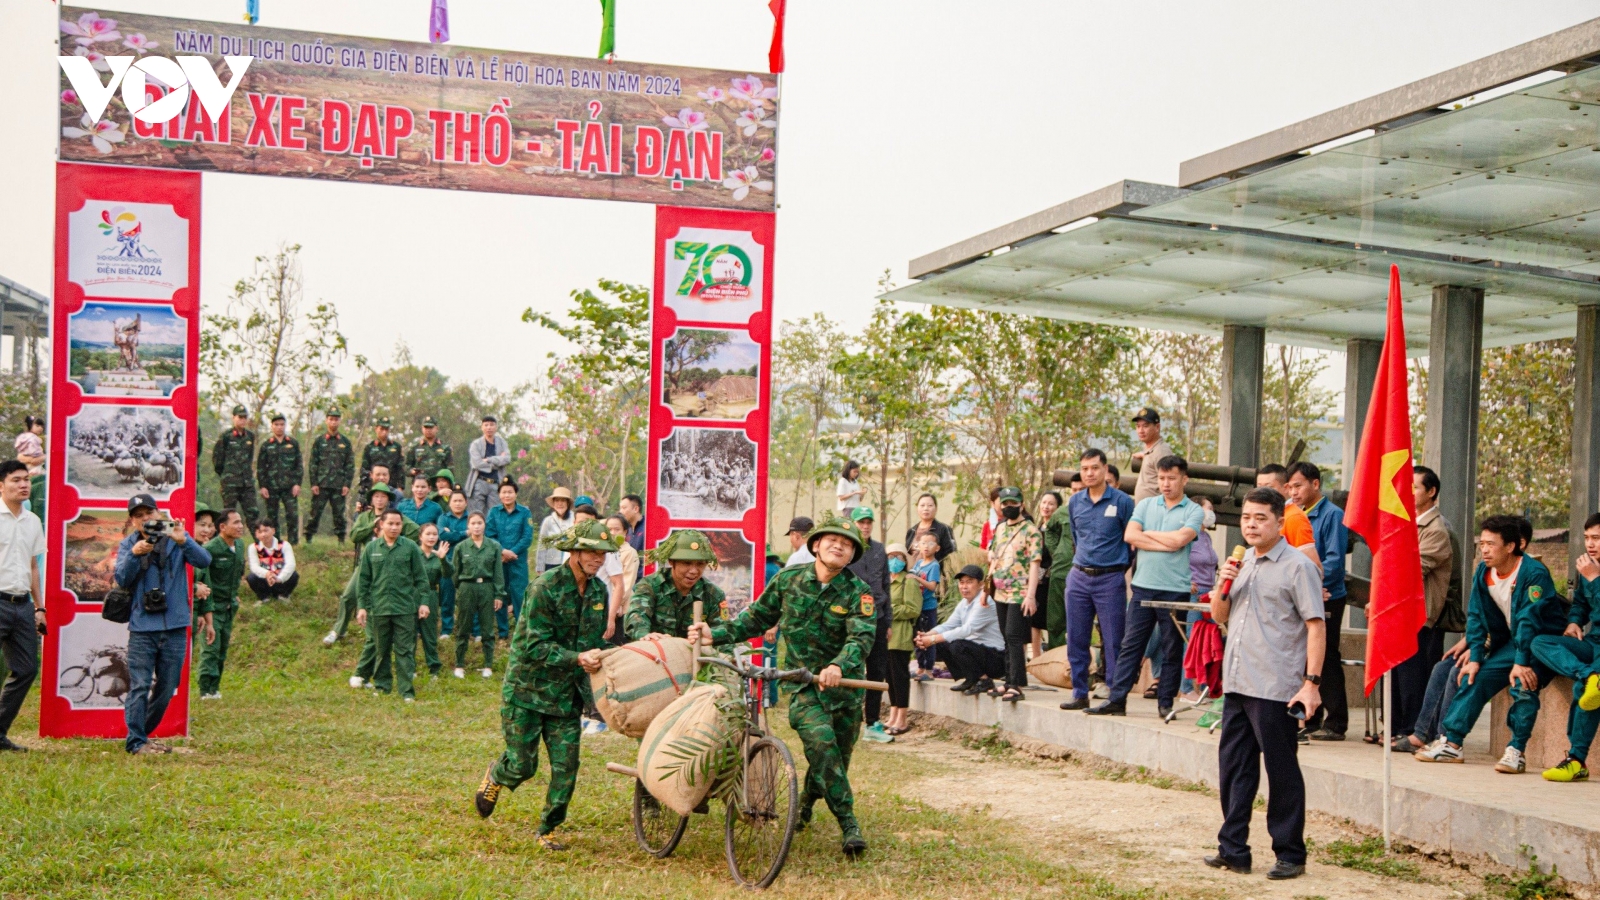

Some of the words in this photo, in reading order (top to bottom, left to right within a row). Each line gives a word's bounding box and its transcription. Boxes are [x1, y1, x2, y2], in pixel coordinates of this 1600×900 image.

[175, 30, 213, 53] NĂM
[220, 37, 242, 56] DU
[250, 38, 285, 64] LỊCH
[291, 38, 335, 65] QUỐC
[341, 48, 367, 68] GIA
[373, 49, 408, 76] ĐIỆN
[414, 53, 449, 77] BIÊN
[456, 54, 475, 80] VÀ
[481, 55, 499, 82] LỄ
[504, 60, 529, 88] HỘI
[534, 66, 565, 87] HOA
[571, 70, 602, 91] BAN
[607, 69, 640, 93] NĂM
[645, 77, 681, 97] 2024
[246, 92, 307, 151] XE
[320, 99, 414, 169] ĐẠP
[428, 97, 513, 167] THỒ
[555, 100, 623, 175] TẢI
[634, 125, 724, 191] ĐẠN
[138, 264, 162, 276] 2024
